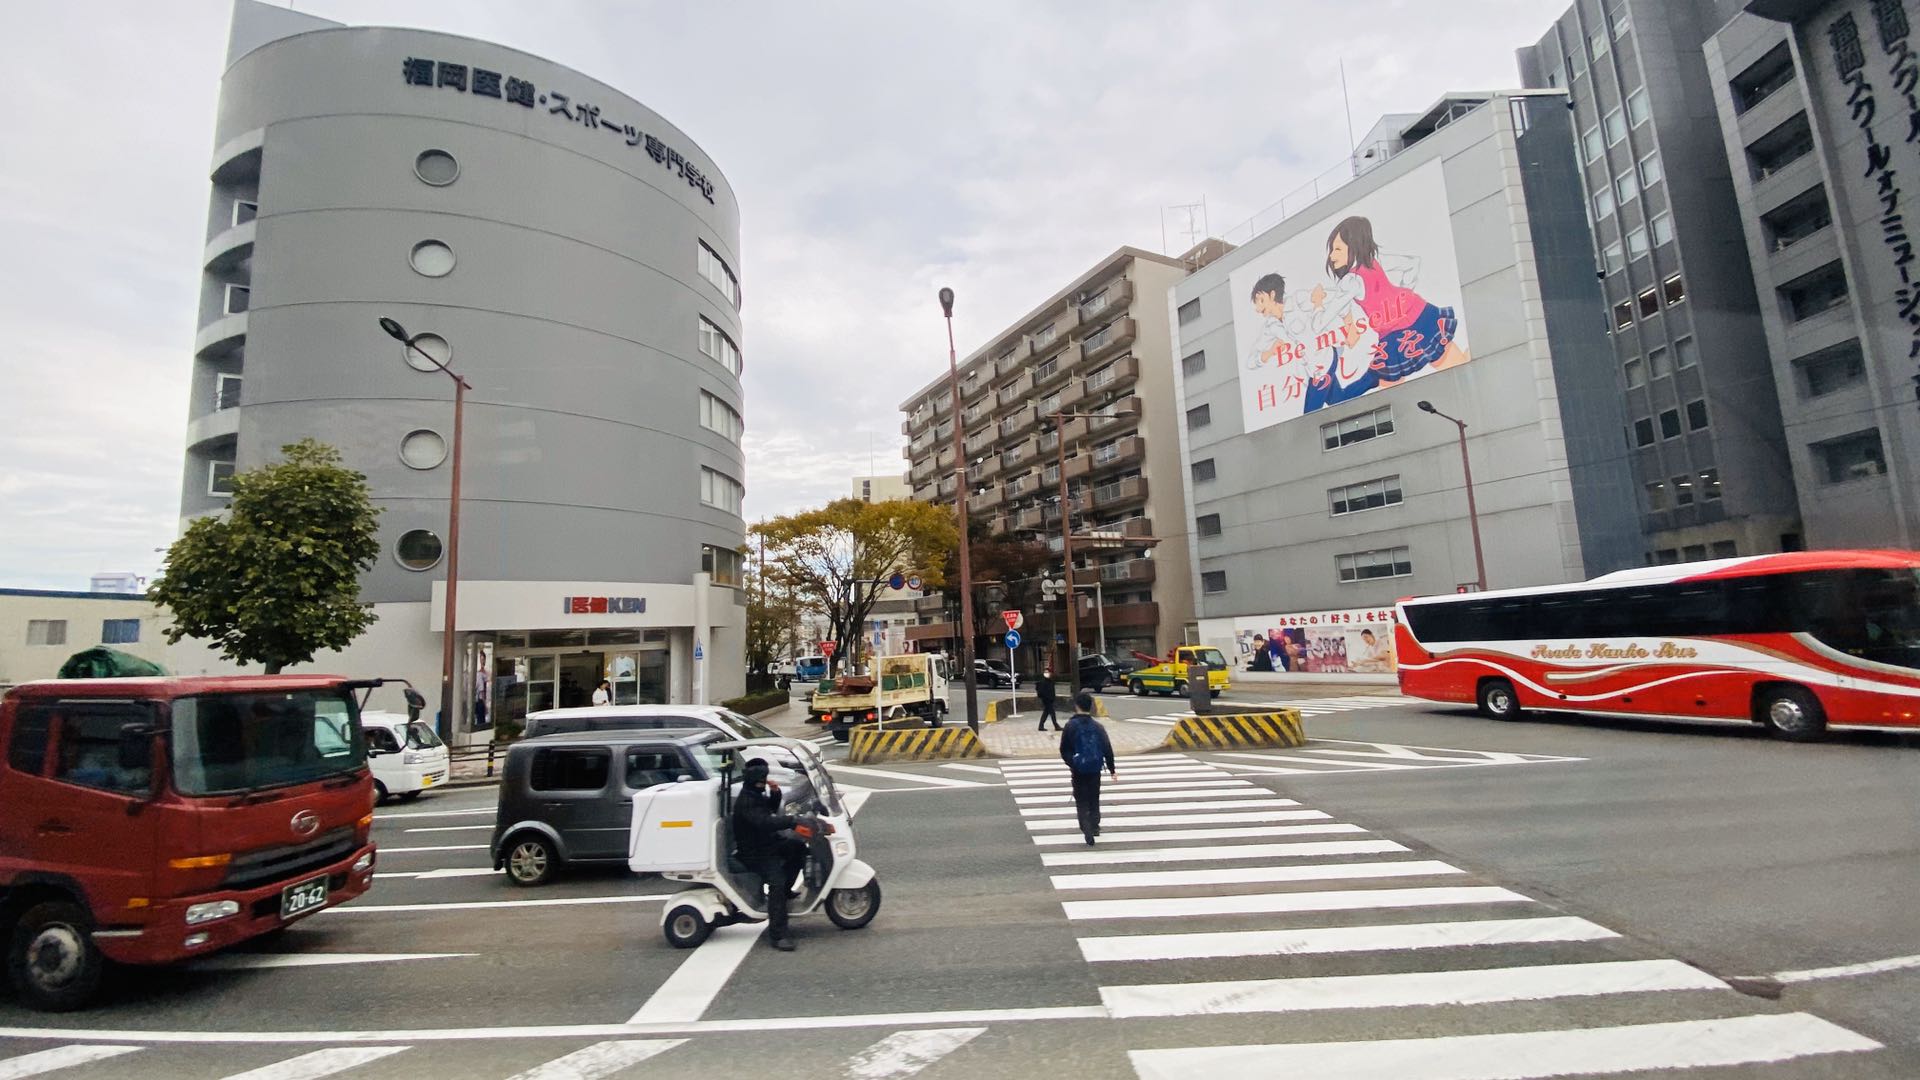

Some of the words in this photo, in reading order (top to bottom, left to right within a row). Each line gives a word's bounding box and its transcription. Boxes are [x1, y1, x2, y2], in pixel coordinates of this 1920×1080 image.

[402, 56, 715, 206] 福岡医健・スポーツ専門学校
[1276, 341, 1306, 369] Be
[1315, 292, 1408, 352] myself
[1585, 643, 1650, 659] Kanko
[1653, 641, 1698, 658] Bus
[290, 886, 323, 911] 20-62
